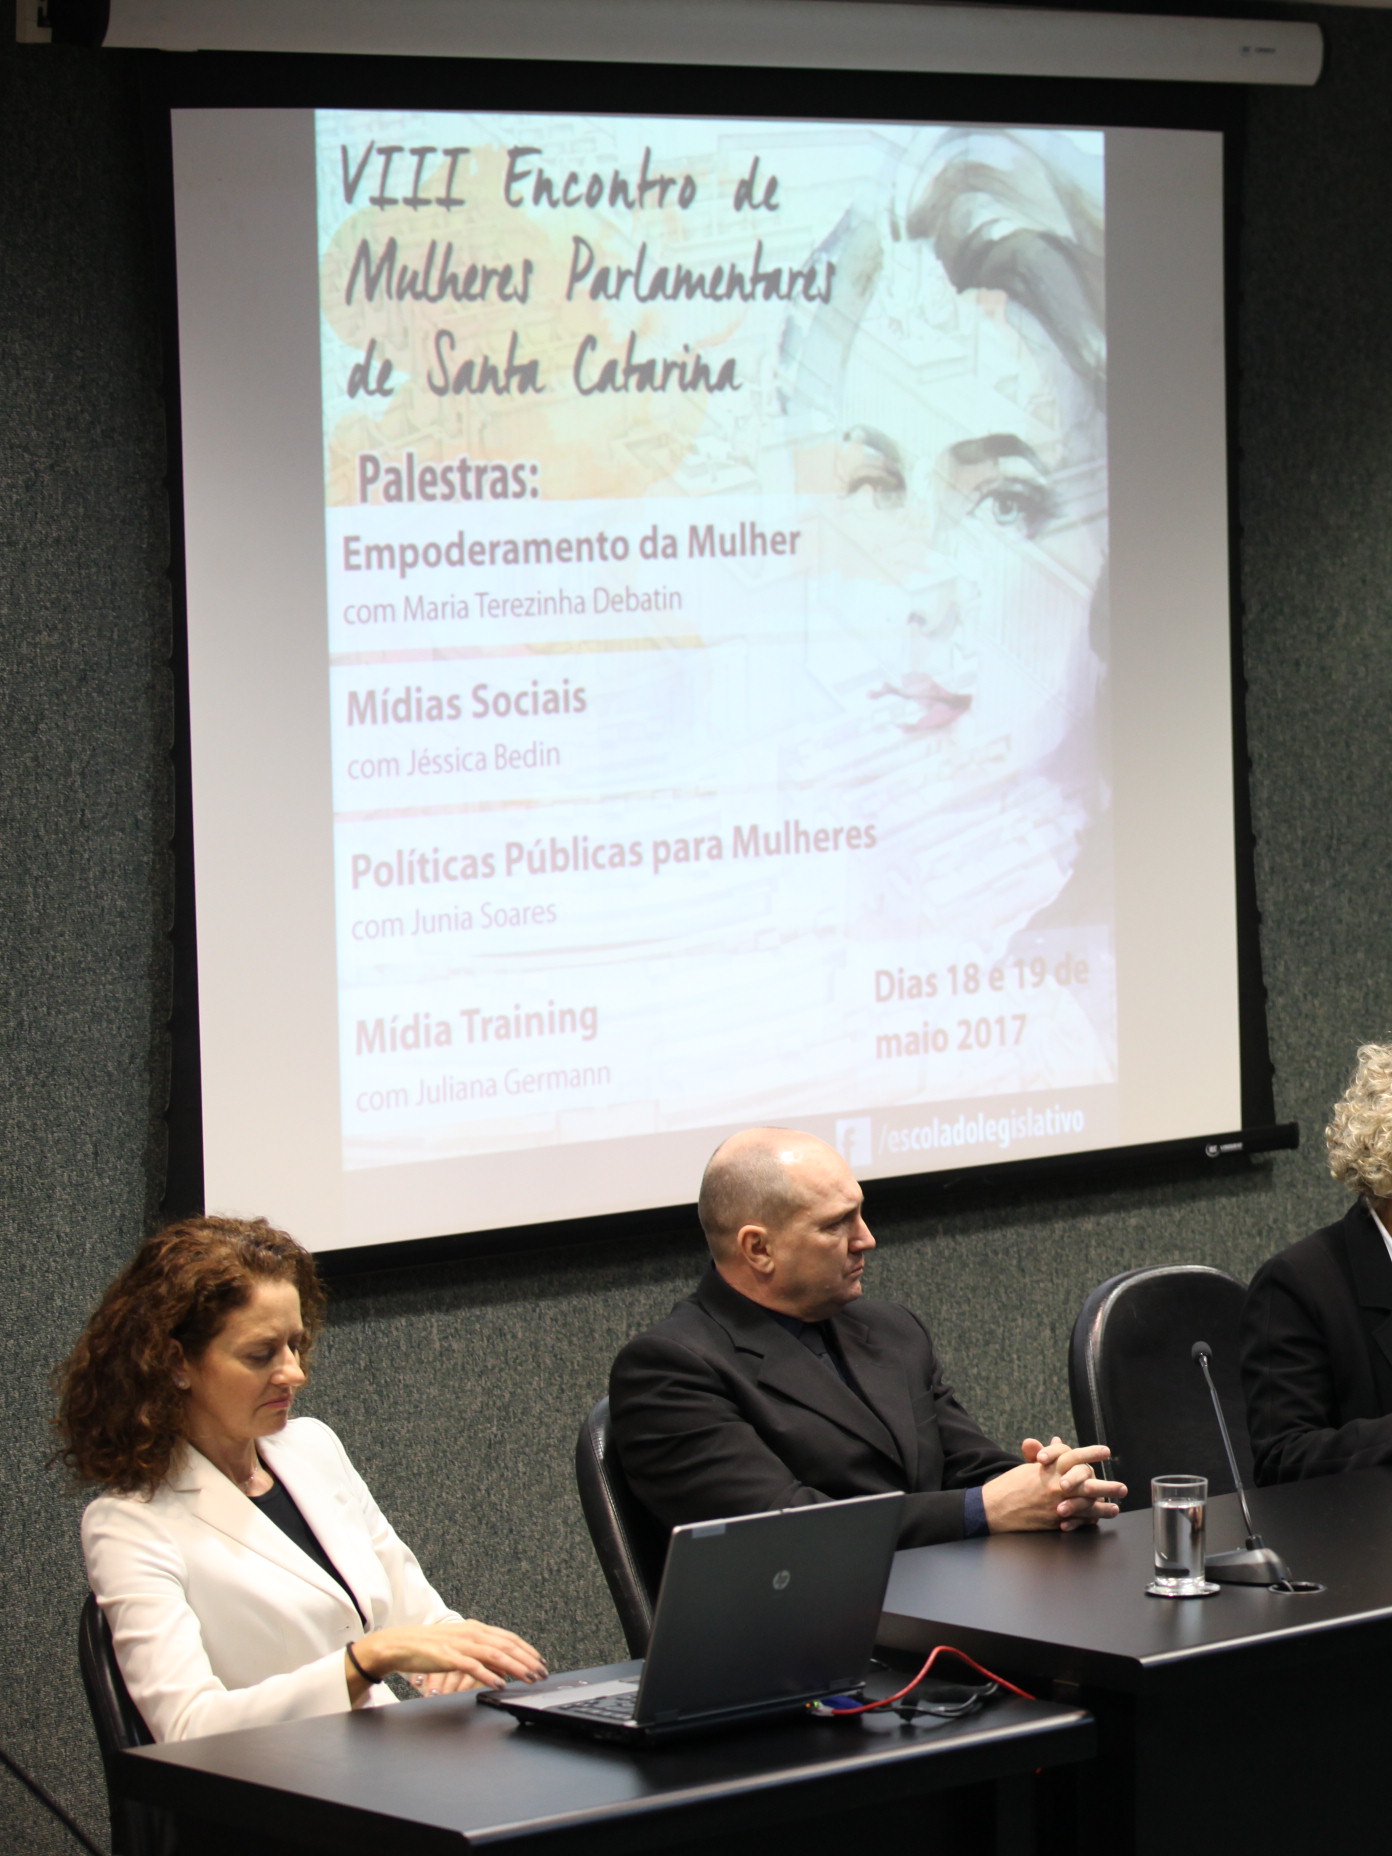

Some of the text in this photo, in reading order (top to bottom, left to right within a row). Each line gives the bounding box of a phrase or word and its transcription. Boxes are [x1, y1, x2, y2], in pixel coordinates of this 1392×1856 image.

[341, 140, 780, 212] VIII Encontro de
[345, 236, 836, 305] Mulheres Parlamentares
[348, 329, 743, 398] de Santa Catarina
[358, 452, 539, 503] Palestras:
[342, 522, 802, 577] Empoderamento da Mulher
[343, 585, 683, 625] com Maria Terezinha Debatin
[347, 679, 587, 727] Mídias Sociais
[347, 741, 561, 780] com Jéssica Bedin
[351, 819, 877, 889] Políticas Públicas para Mulheres
[351, 902, 557, 940] com Junia Soares
[875, 952, 1089, 1003] Dias 18 e 19 de
[356, 1000, 599, 1056] Mídia Training
[876, 1014, 1027, 1059] maio 2017
[356, 1065, 611, 1112] com Juliana Germann
[878, 1104, 1085, 1155] /escoladolegislativo
